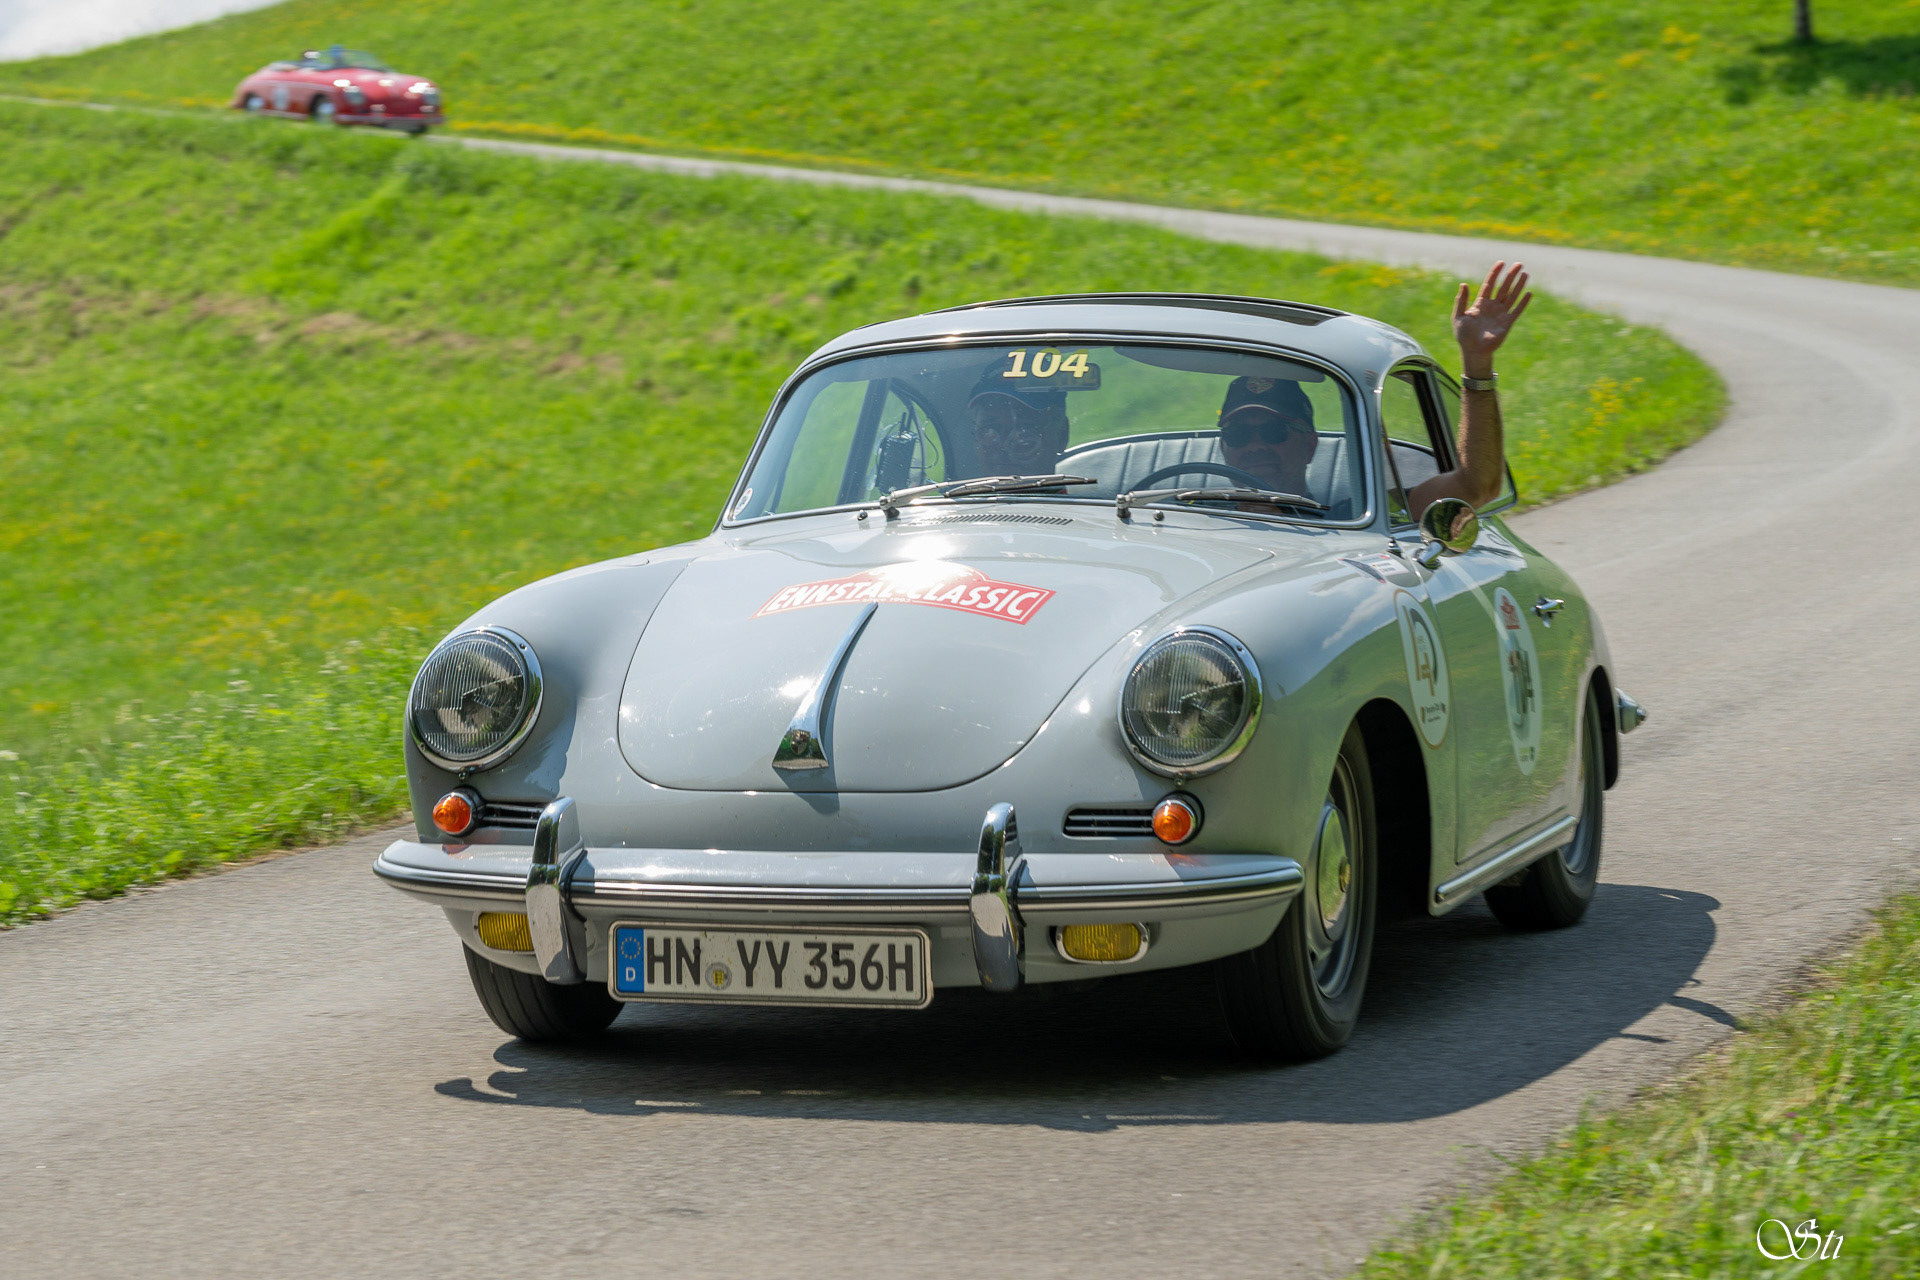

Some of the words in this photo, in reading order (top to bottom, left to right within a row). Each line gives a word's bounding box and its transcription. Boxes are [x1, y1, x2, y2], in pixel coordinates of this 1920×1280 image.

[1002, 348, 1090, 378] 104
[625, 967, 636, 982] D
[646, 937, 702, 986] HN
[736, 940, 790, 988] YY
[803, 942, 914, 992] 356H
